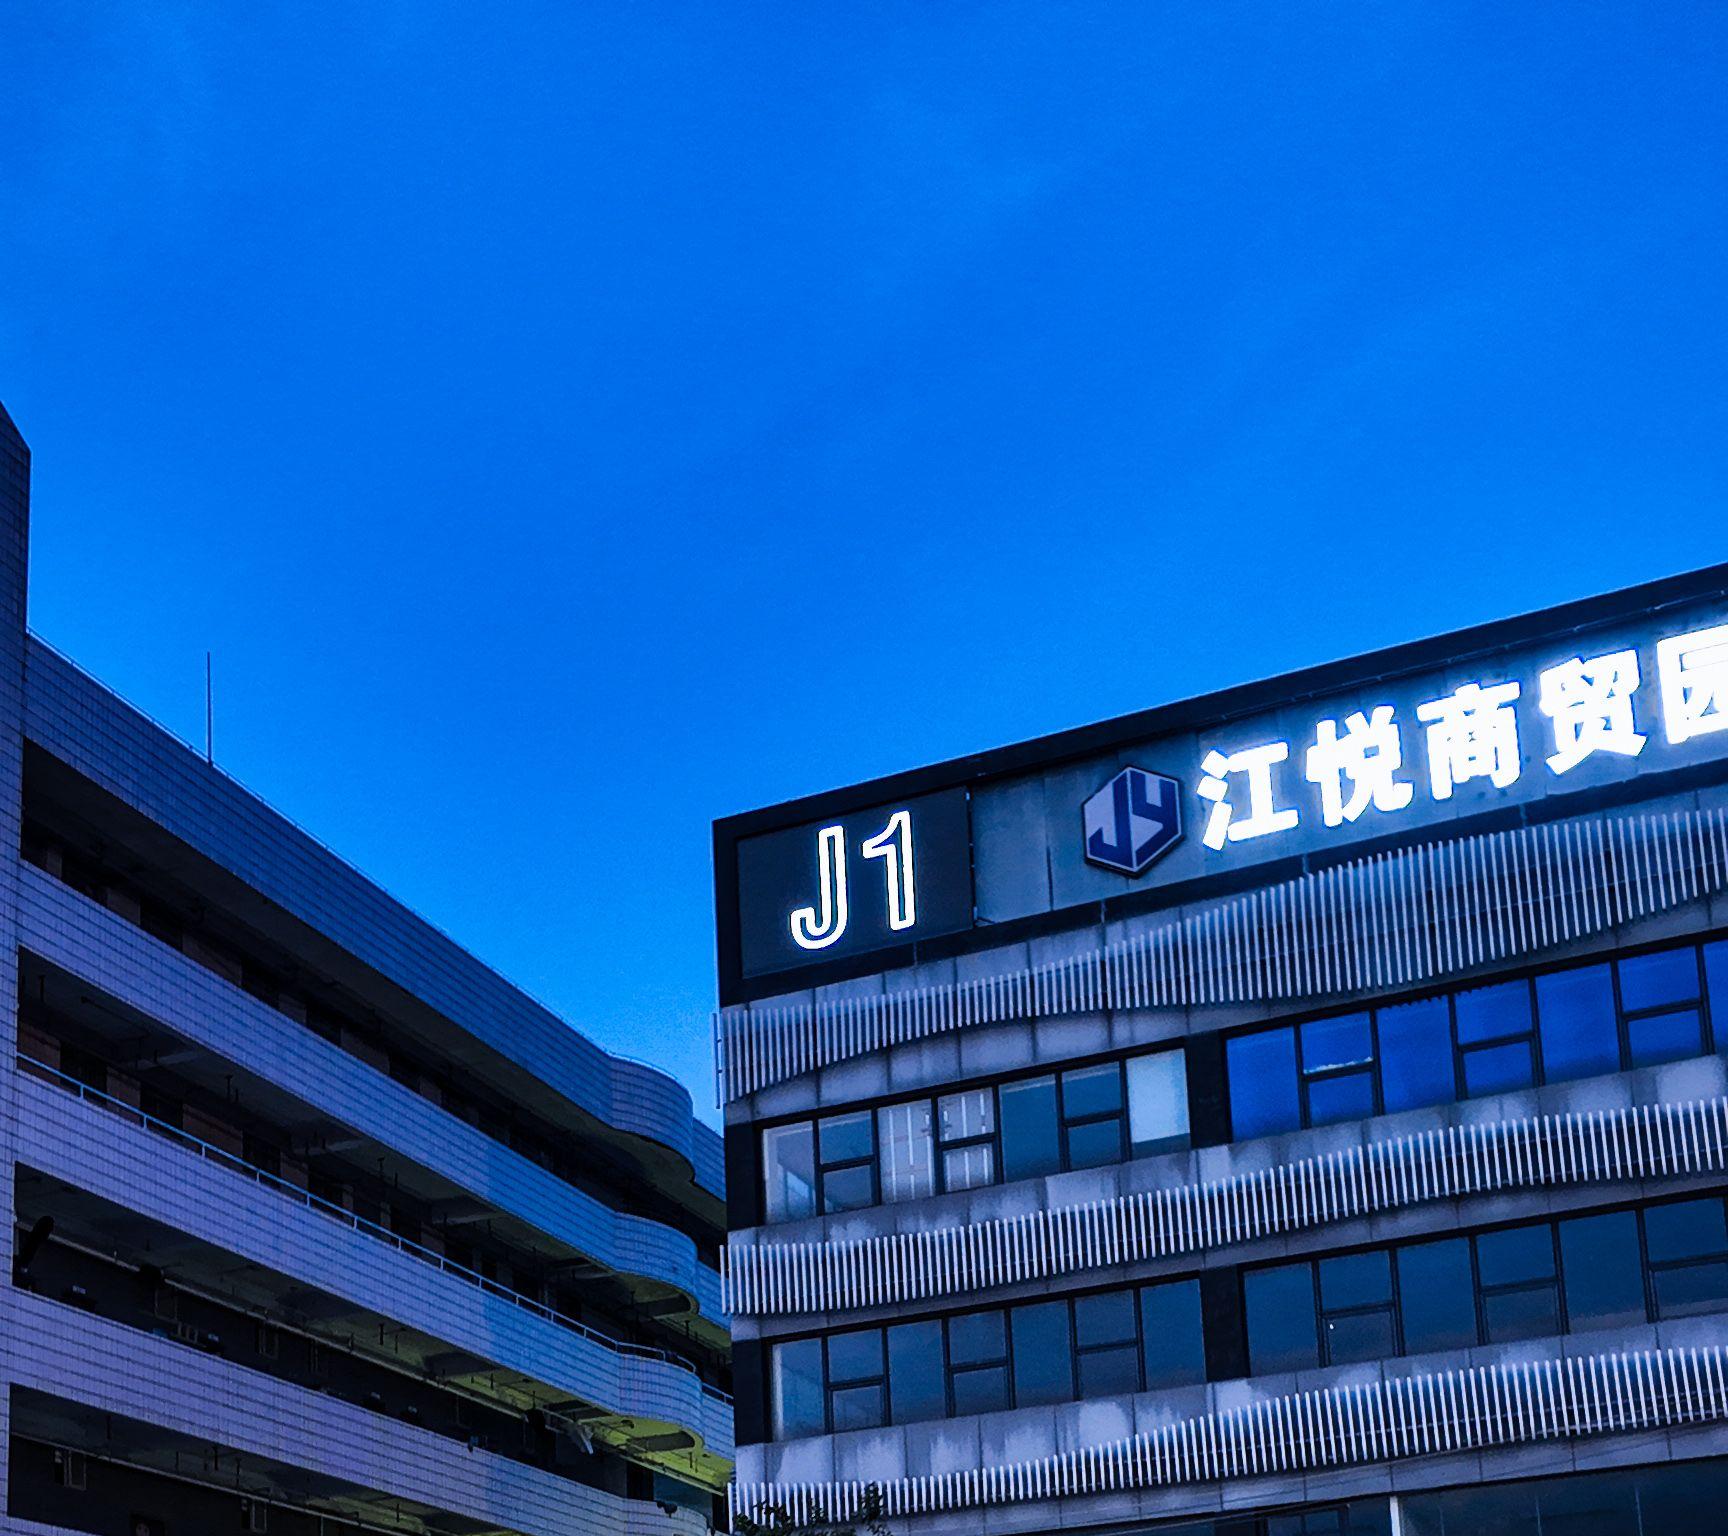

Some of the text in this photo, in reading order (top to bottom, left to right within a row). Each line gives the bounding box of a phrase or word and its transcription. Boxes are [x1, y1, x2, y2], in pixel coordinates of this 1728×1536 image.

[1197, 624, 1728, 852] 江悦商贸园
[788, 808, 918, 951] J1
